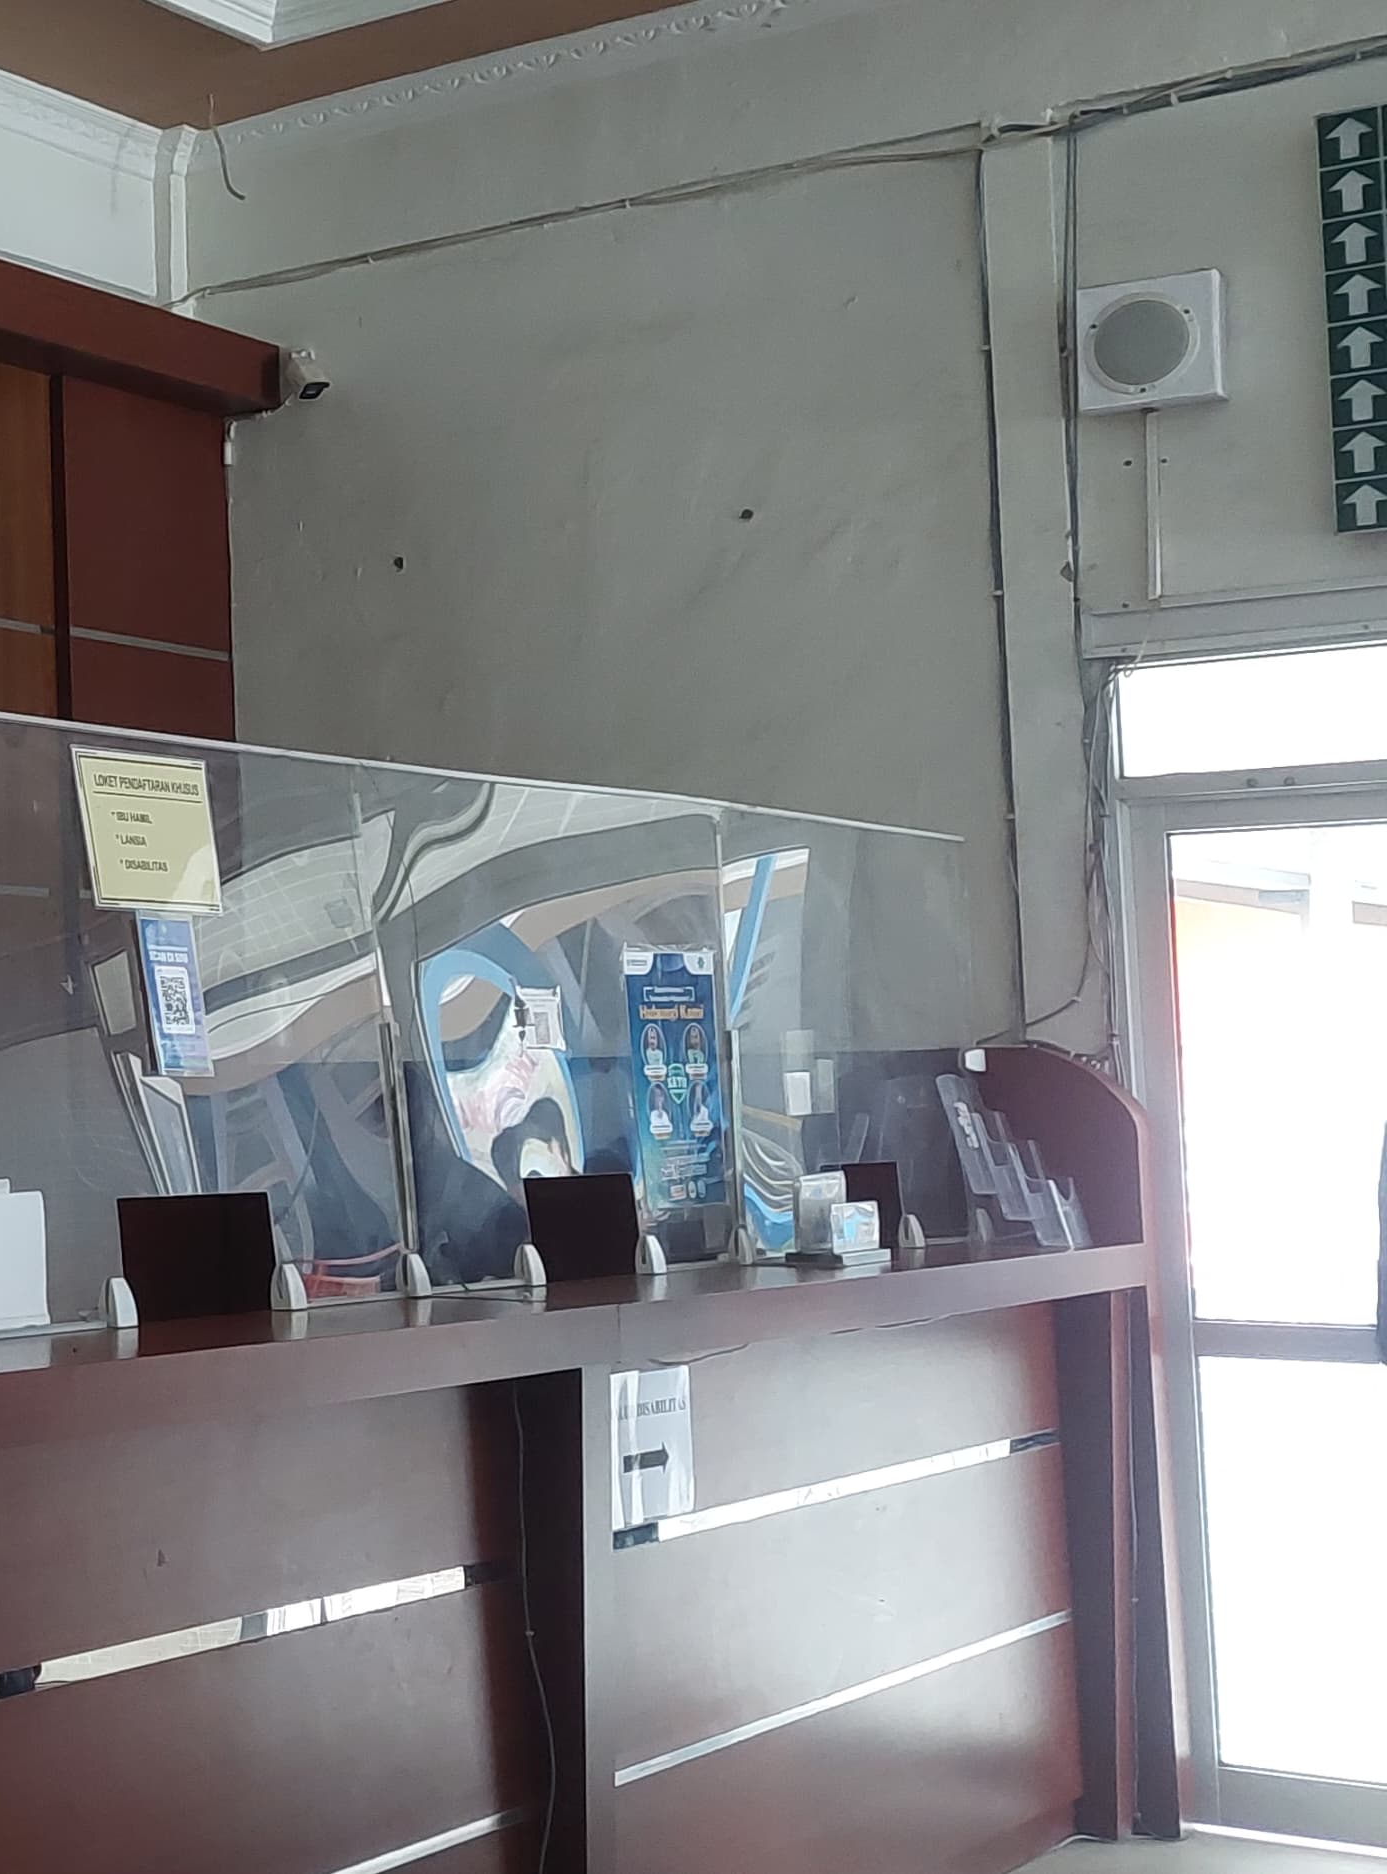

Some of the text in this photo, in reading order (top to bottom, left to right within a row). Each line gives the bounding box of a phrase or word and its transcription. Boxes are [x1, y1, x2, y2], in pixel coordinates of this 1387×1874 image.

[93, 773, 200, 796] LOKET PENDAFTARAN KHUSUS
[120, 834, 147, 847] LANSIA
[125, 859, 169, 873] DISABILITAS
